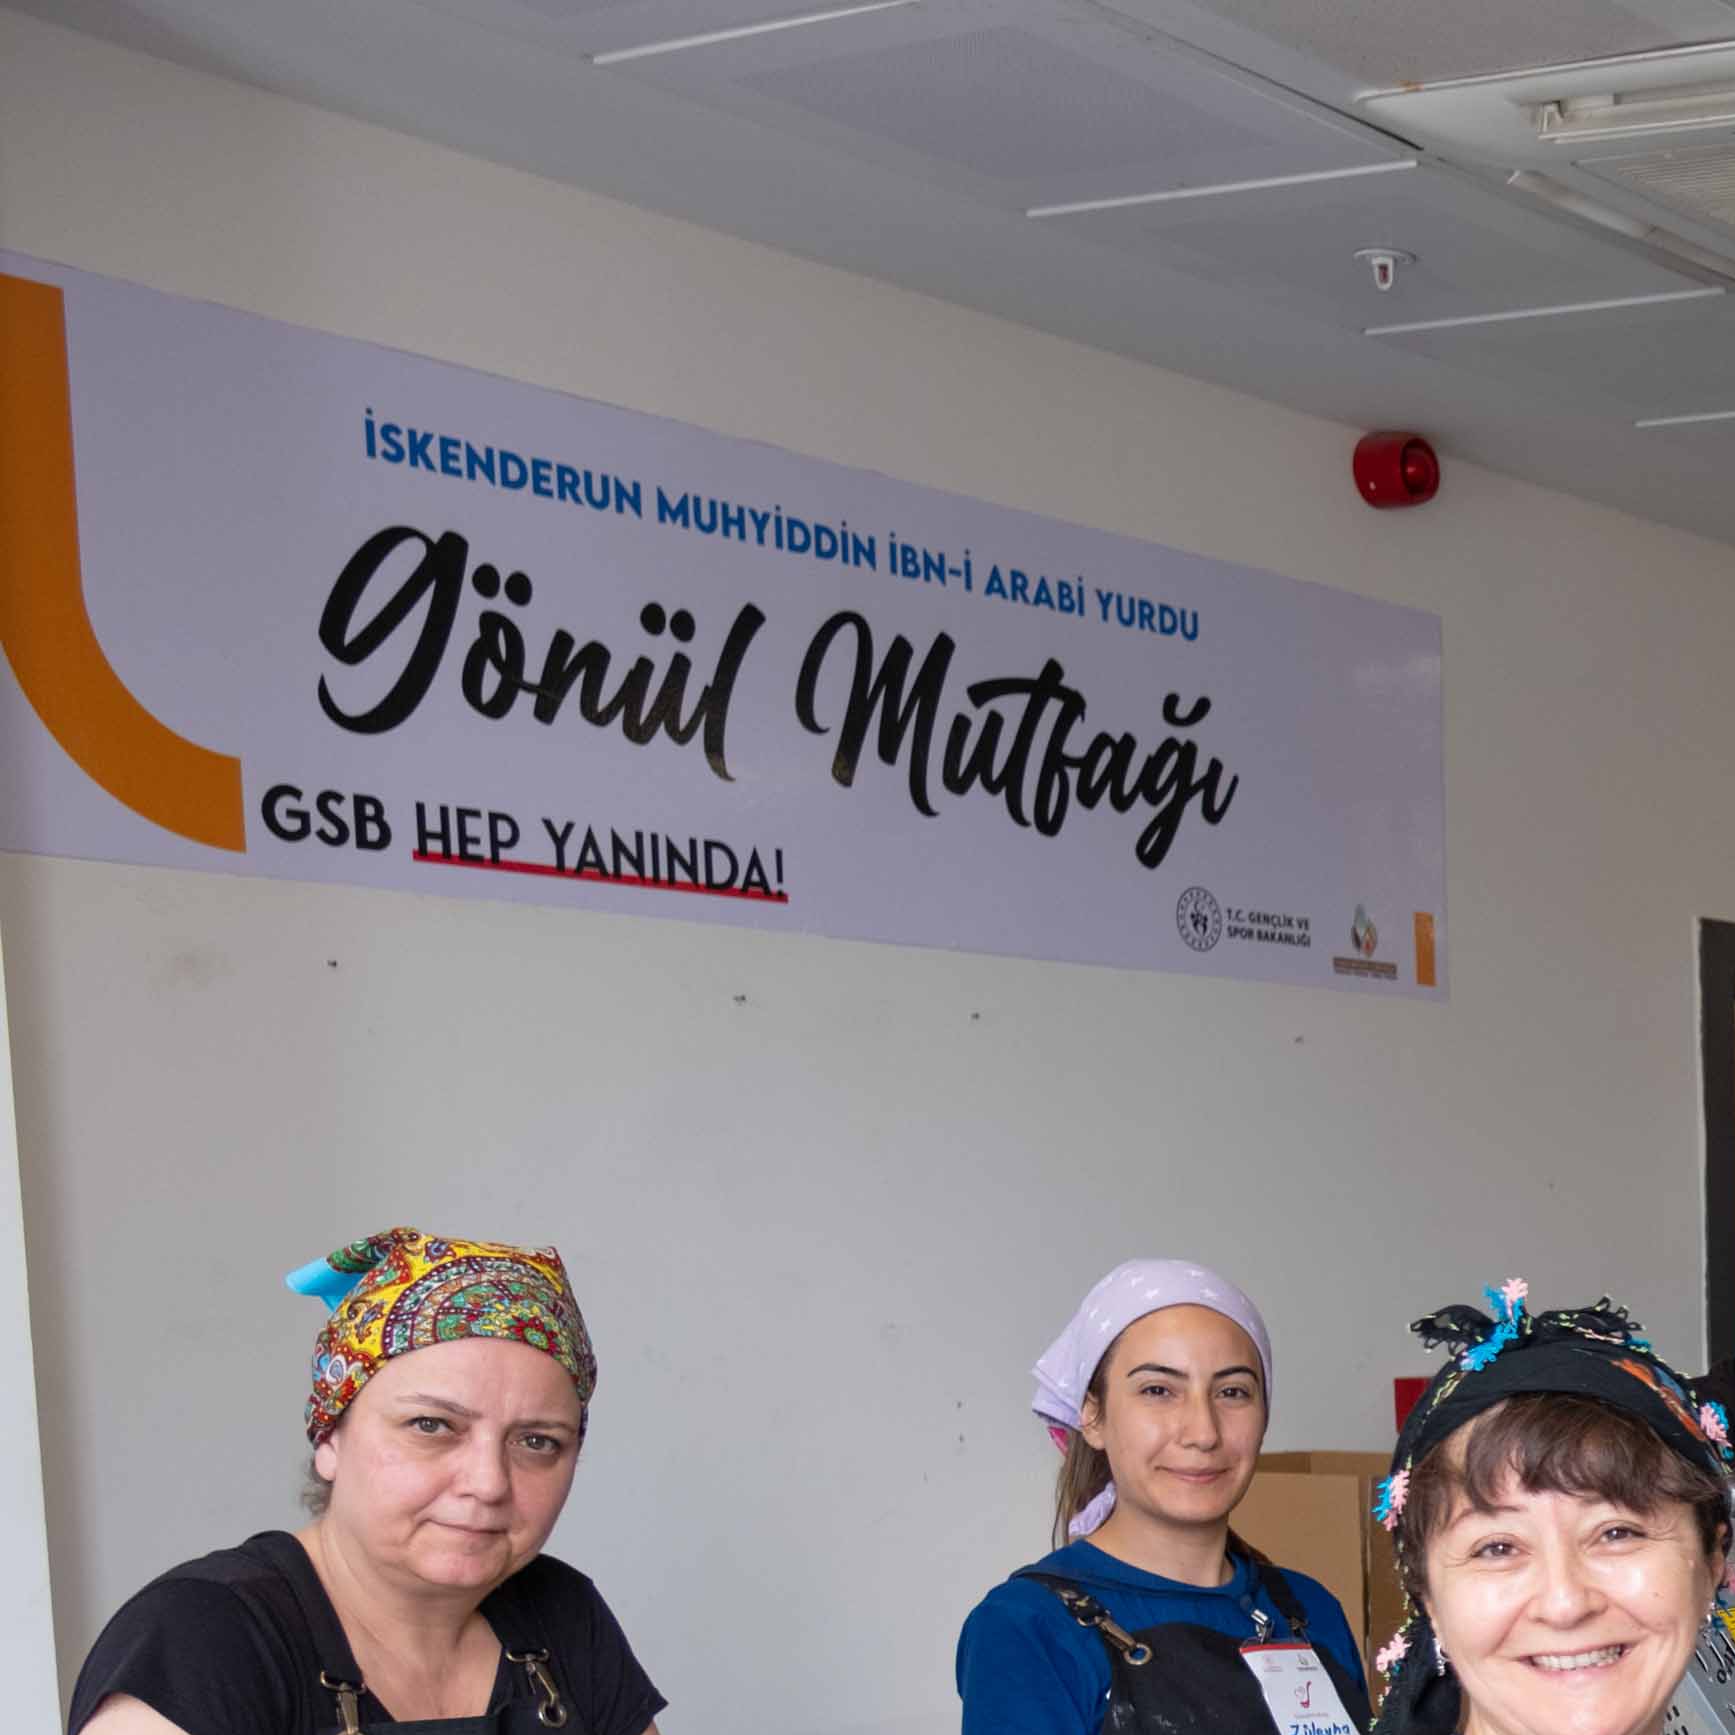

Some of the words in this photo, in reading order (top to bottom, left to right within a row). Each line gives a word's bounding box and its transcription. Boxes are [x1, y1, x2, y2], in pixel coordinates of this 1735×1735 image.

[363, 408, 642, 518] İSKENDERUN
[656, 486, 876, 571] MUHYİDDİN
[889, 532, 973, 591] İBN-İ
[985, 564, 1085, 617] ARABİ
[1096, 588, 1199, 642] YURDU
[799, 610, 1239, 870] Mutfağı
[261, 783, 392, 851] GSB
[414, 802, 520, 864] HEP
[542, 817, 785, 896] YANINDA!
[1227, 927, 1254, 940] SPOR
